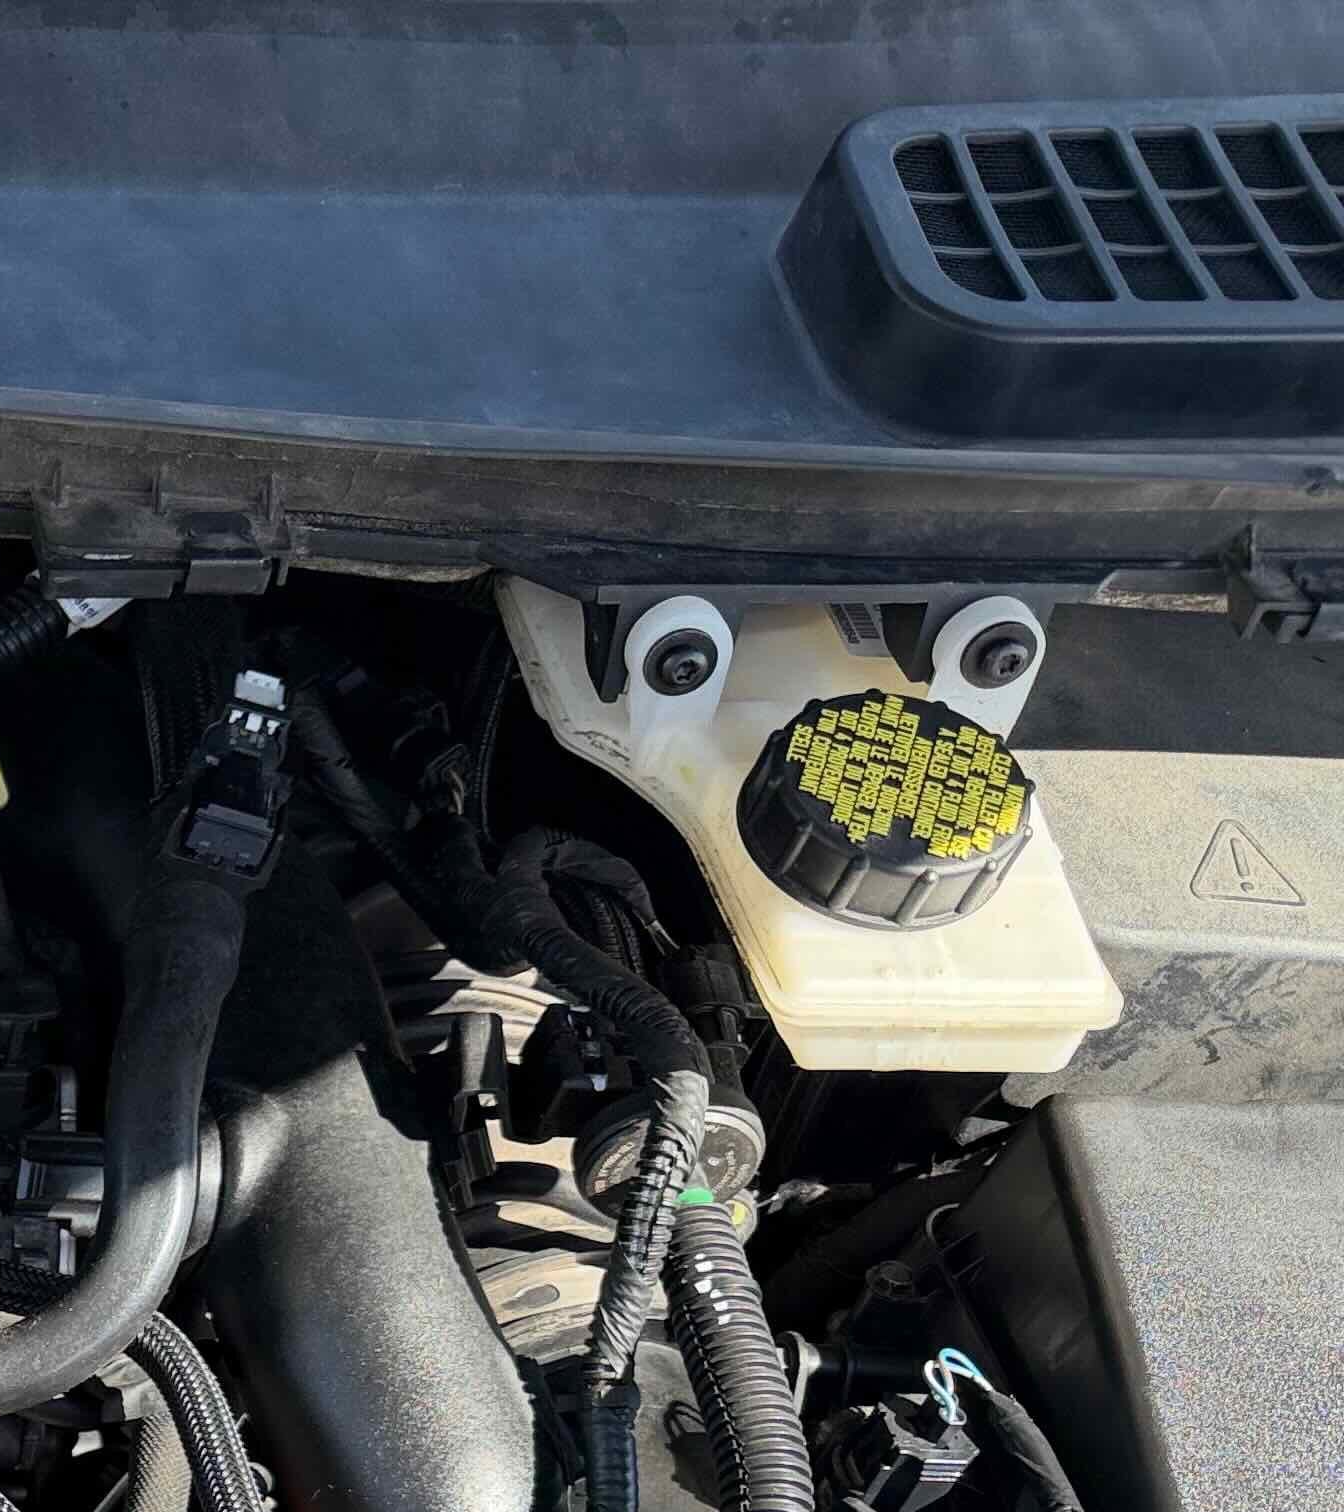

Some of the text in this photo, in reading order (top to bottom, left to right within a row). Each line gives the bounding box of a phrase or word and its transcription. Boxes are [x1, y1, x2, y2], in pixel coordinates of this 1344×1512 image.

[880, 695, 905, 728] AVANT
[875, 728, 895, 744] DE
[938, 727, 957, 738] A
[798, 735, 832, 795] CONTENANT
[816, 709, 859, 804] DOT 4 PROVENANT
[831, 700, 882, 826] PLOYER QUE DU LIQUIDE
[870, 744, 891, 762] LE
[928, 739, 954, 779] SEALED
[971, 734, 996, 775] BEFORE
[988, 752, 1012, 787] CLEAN
[870, 711, 920, 837] NETTOYER LE BOUCHON
[928, 726, 978, 858] ONLY DOT 4 FLUID FROM
[977, 788, 1004, 827] FILLER
[947, 835, 972, 860] USE
